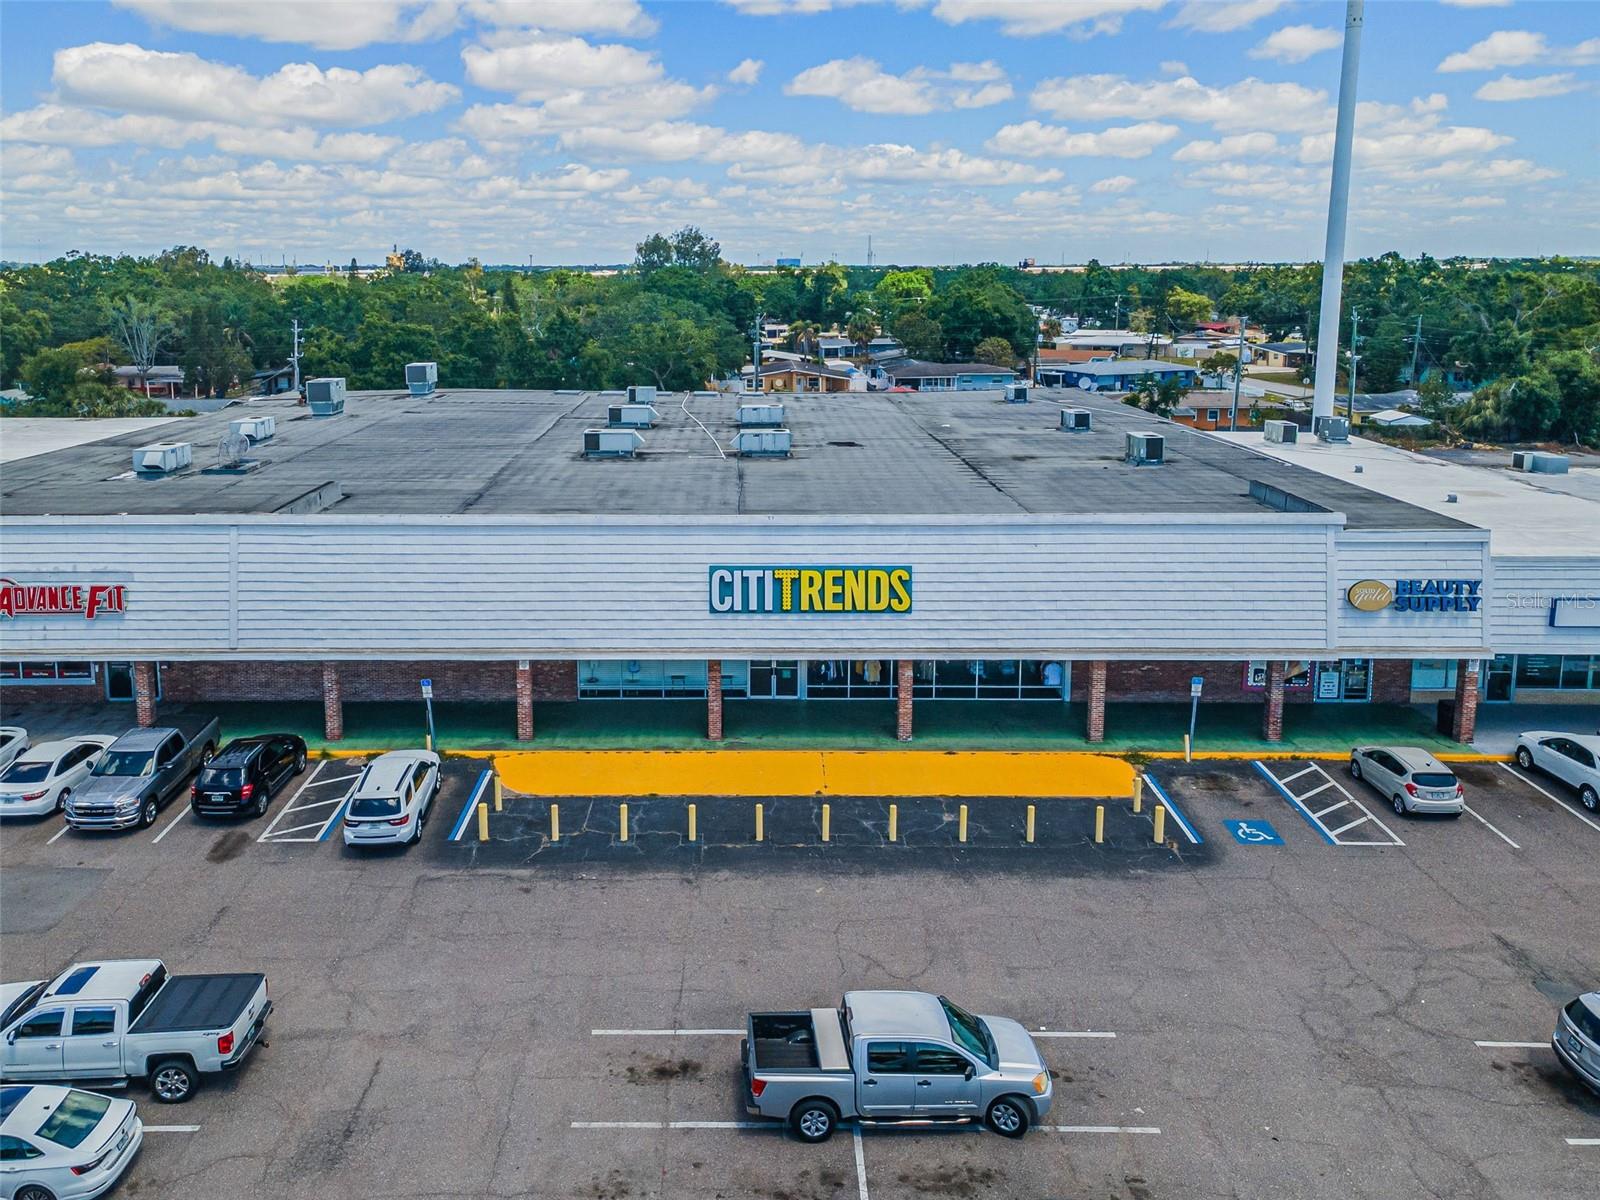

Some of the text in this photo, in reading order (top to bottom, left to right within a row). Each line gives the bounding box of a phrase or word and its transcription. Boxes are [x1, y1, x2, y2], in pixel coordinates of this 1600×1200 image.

[1395, 580, 1482, 596] BEAUTY
[0, 586, 83, 618] ADVANCE
[1394, 596, 1482, 612] SUPPLY
